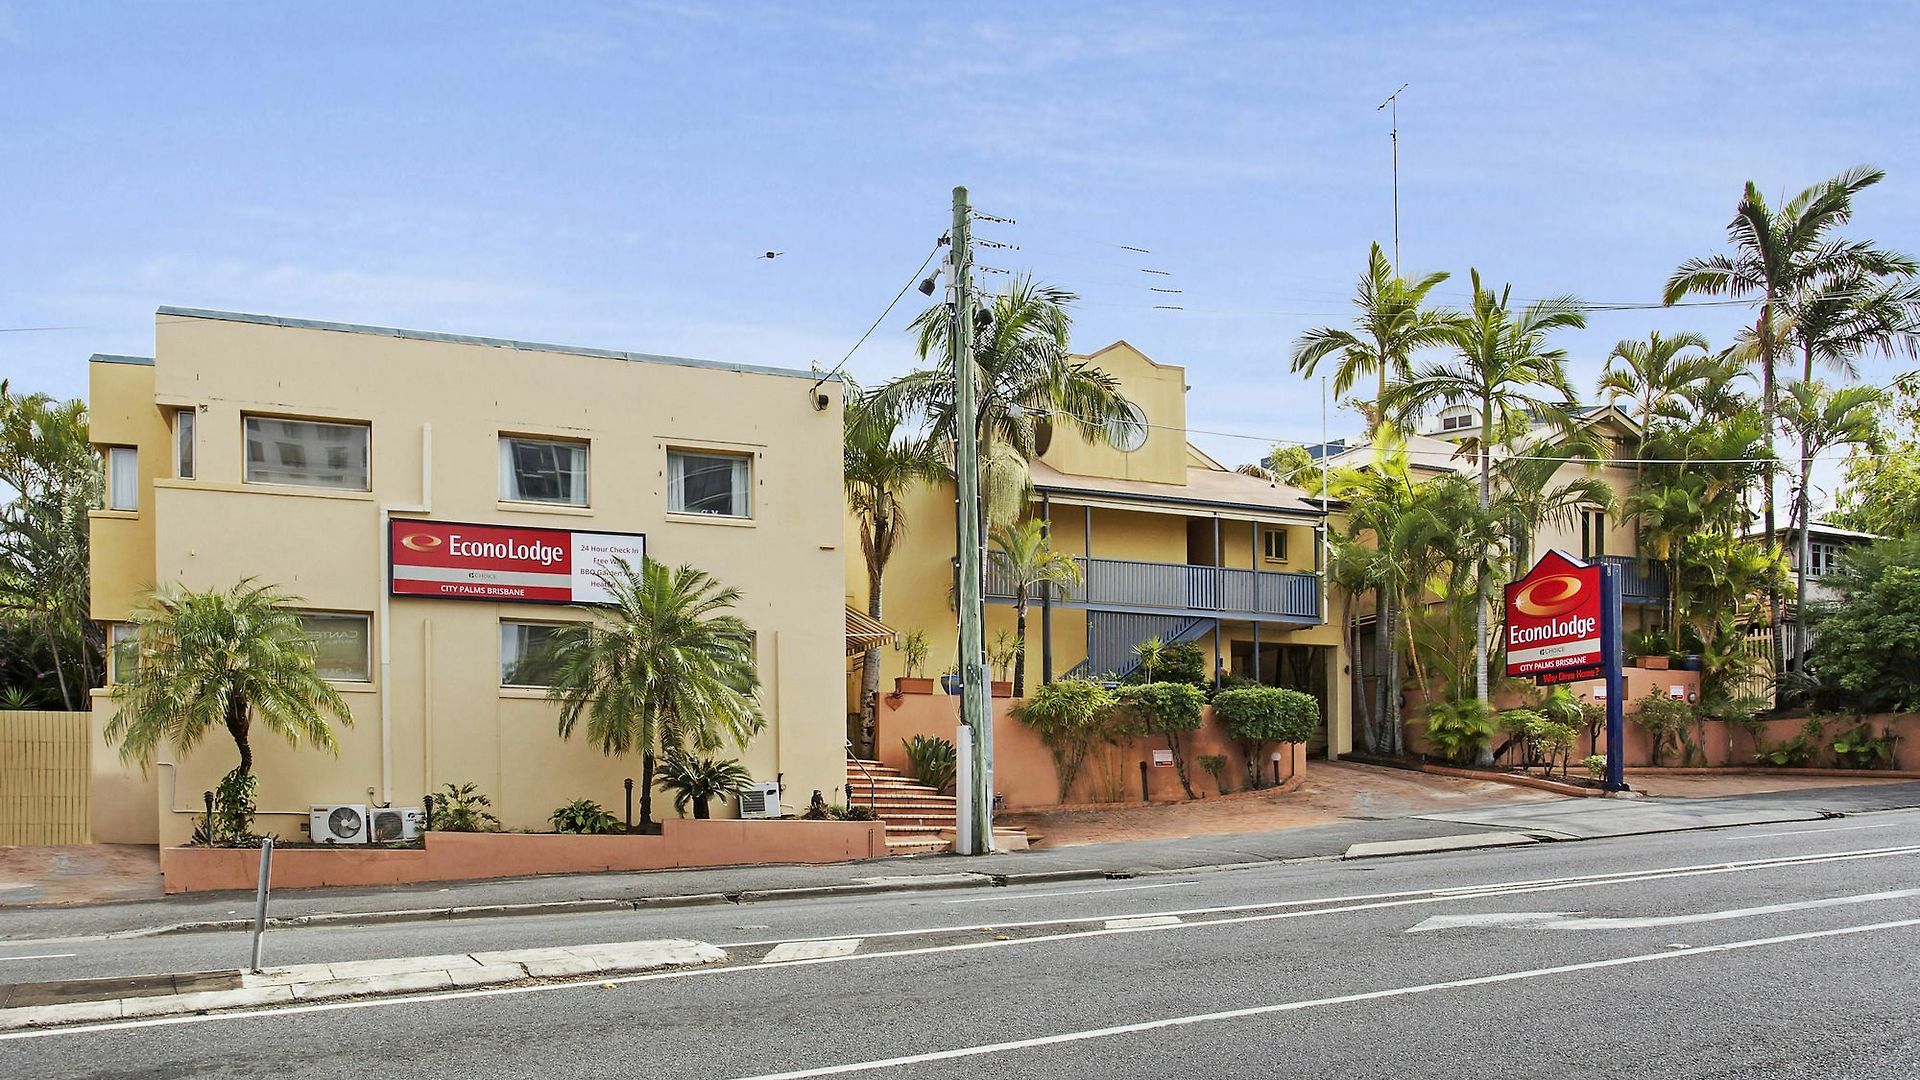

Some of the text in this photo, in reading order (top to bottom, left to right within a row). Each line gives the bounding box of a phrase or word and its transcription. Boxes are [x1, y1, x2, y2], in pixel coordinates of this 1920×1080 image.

[449, 535, 563, 566] EconoLodge
[460, 586, 485, 594] PALMS
[487, 587, 525, 596] BRISBANE
[1510, 615, 1595, 644] EconoLodge
[1520, 656, 1587, 672] CITY PALMS BRISBANE
